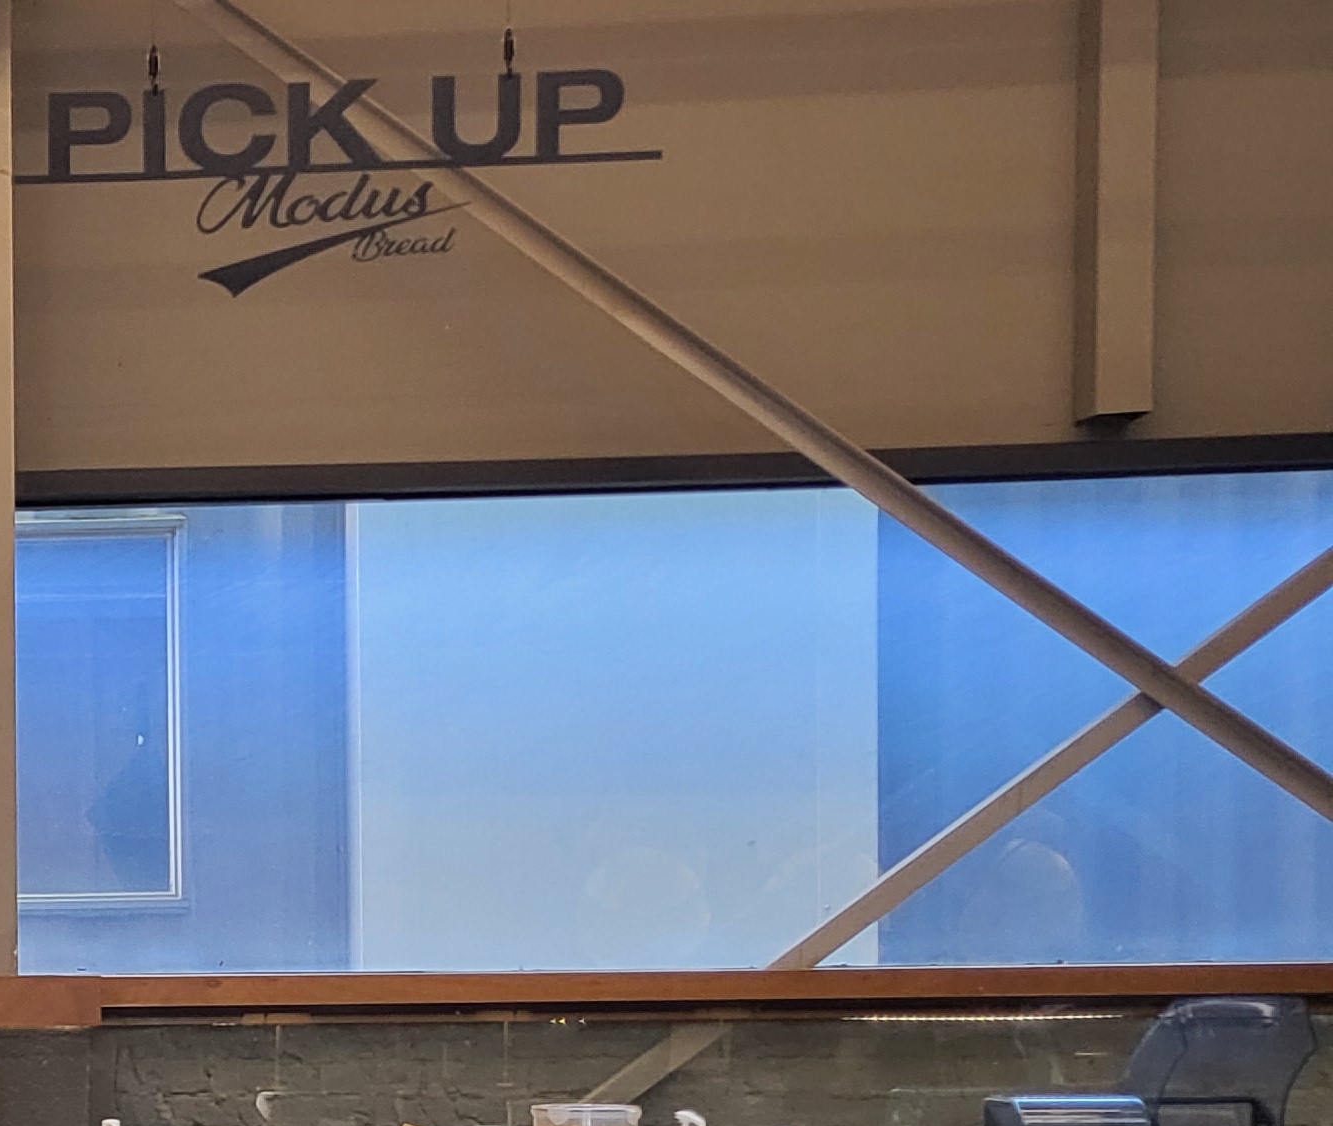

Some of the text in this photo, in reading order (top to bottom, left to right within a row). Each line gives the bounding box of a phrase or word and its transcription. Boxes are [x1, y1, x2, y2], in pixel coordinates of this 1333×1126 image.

[48, 71, 625, 178] PICK UP
[196, 174, 434, 235] Modus
[351, 228, 457, 262] Bread
